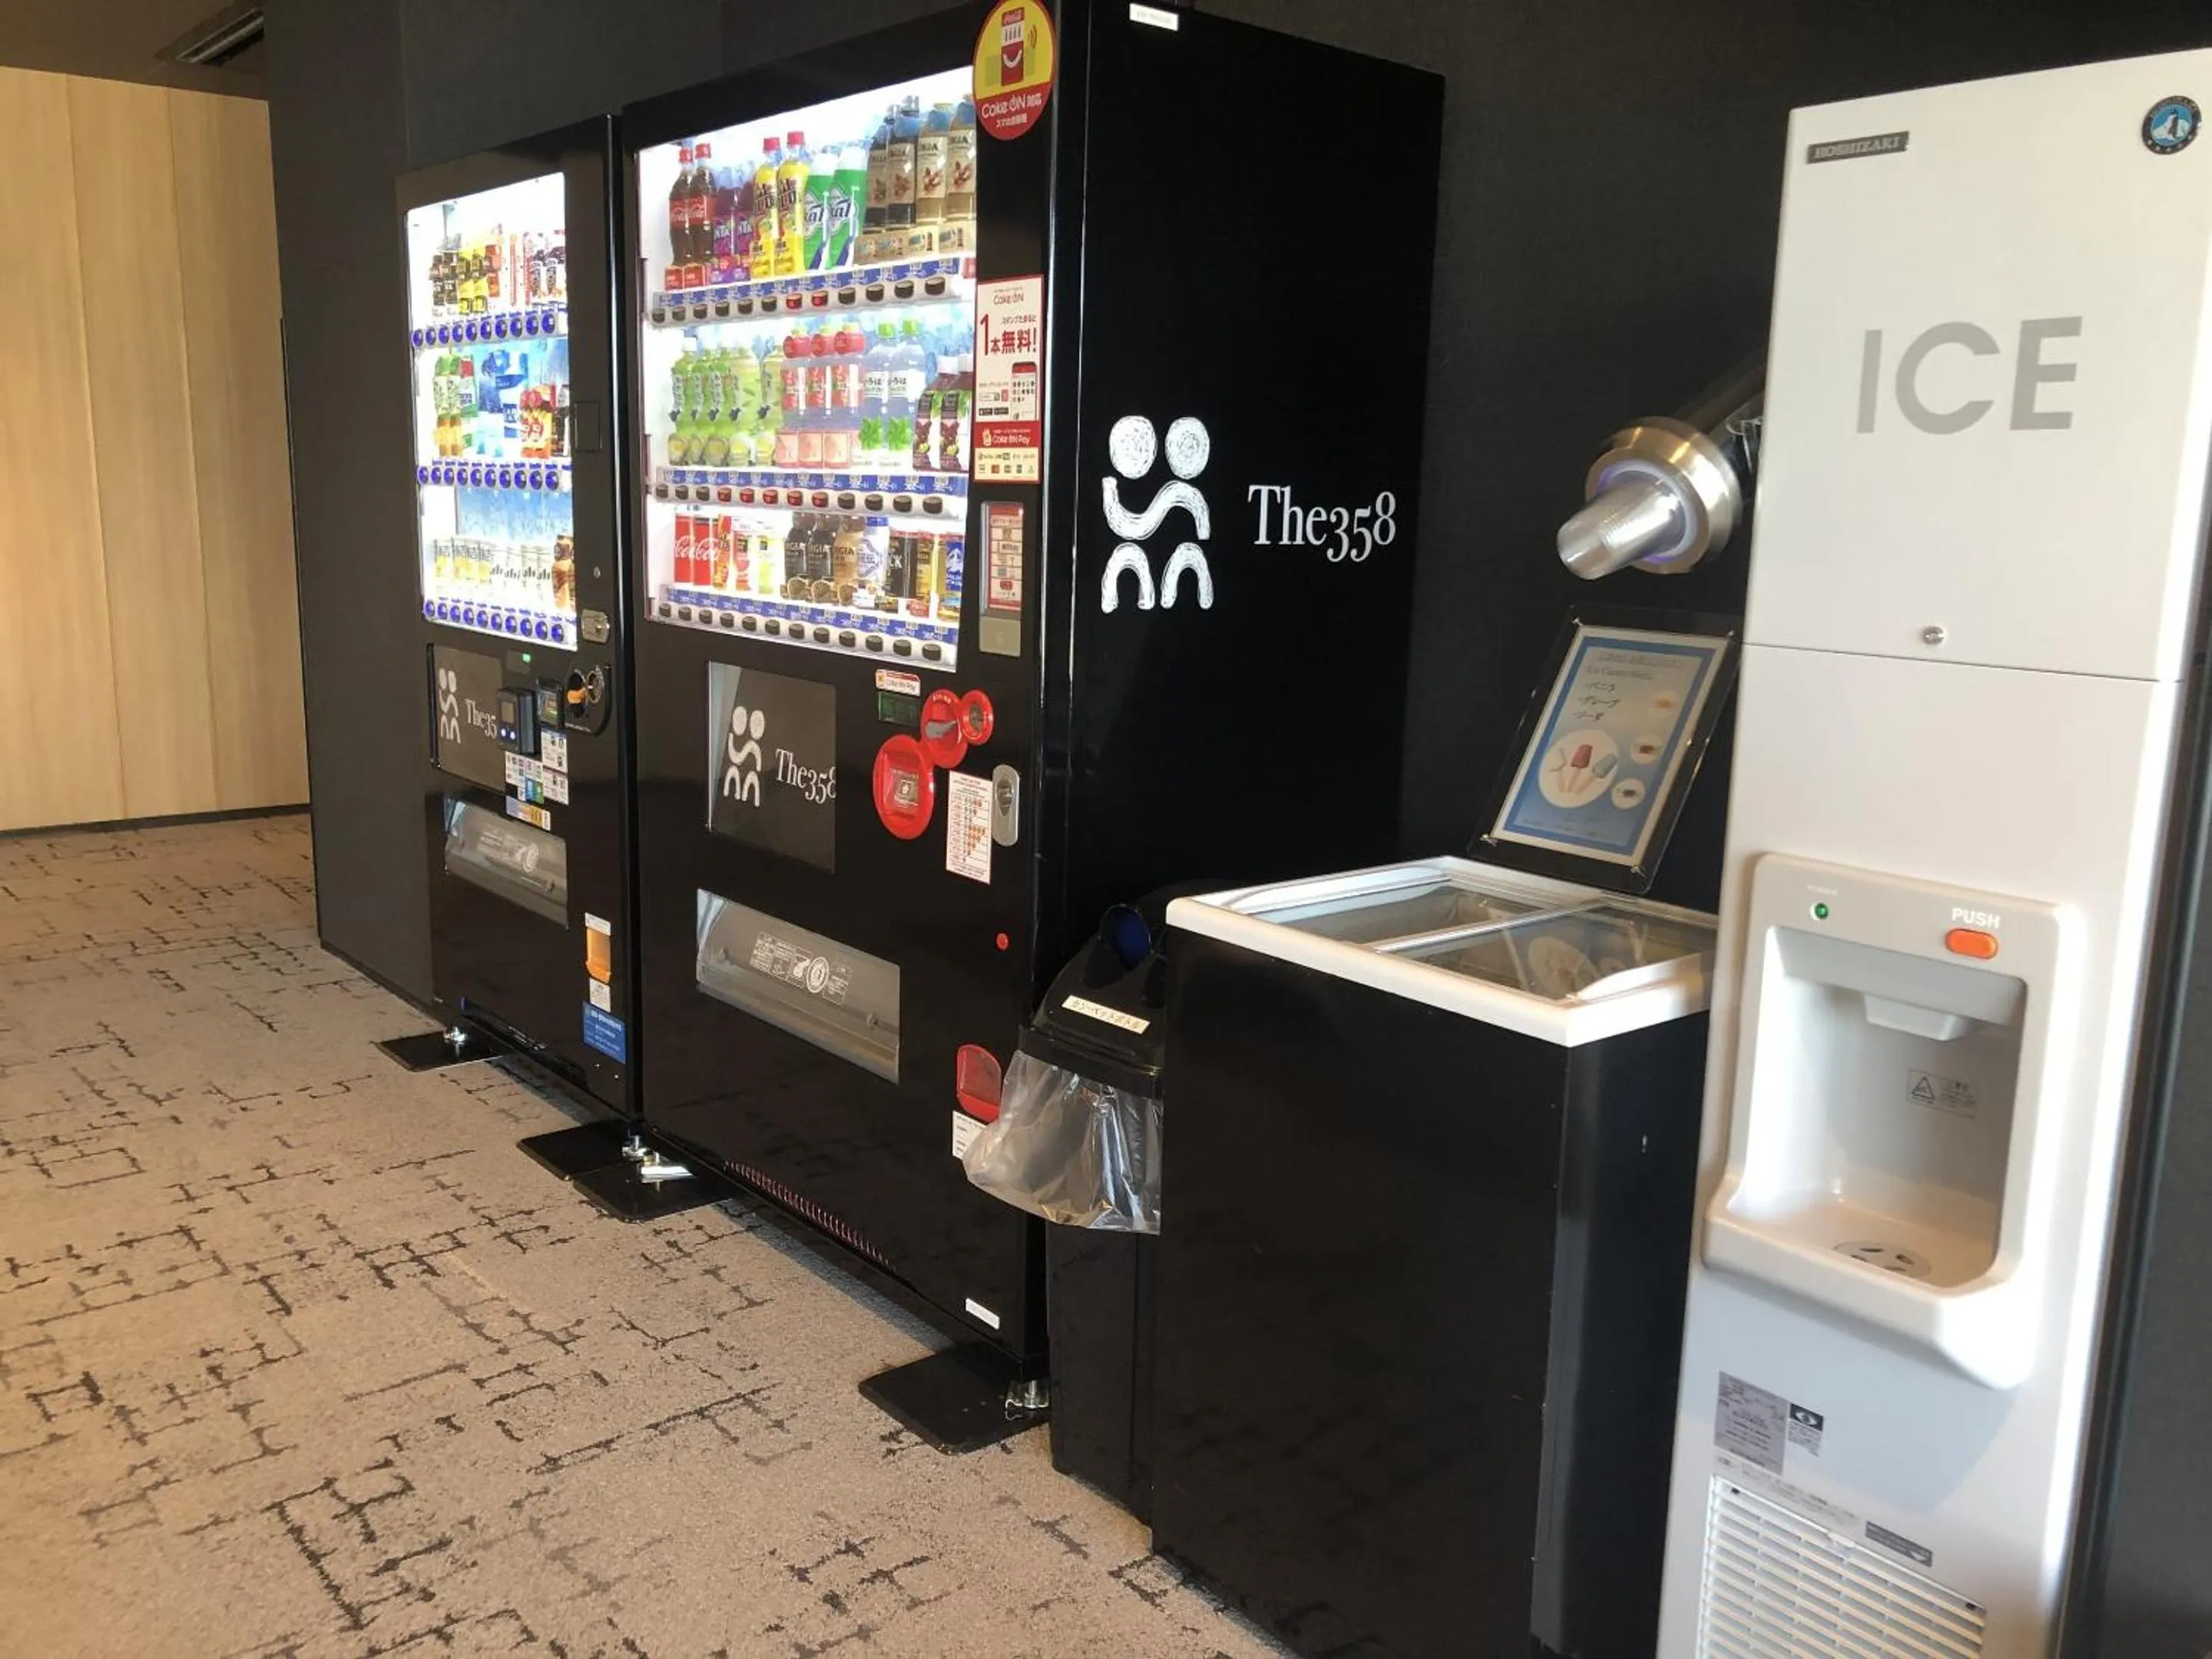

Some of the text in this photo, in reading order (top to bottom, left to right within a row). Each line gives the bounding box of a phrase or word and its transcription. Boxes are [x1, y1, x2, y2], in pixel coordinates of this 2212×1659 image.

[1856, 316, 2083, 435] ICE
[1247, 485, 1397, 563] The358
[464, 698, 498, 740] The35
[775, 748, 836, 804] The358
[1951, 907, 2002, 929] PUSH
